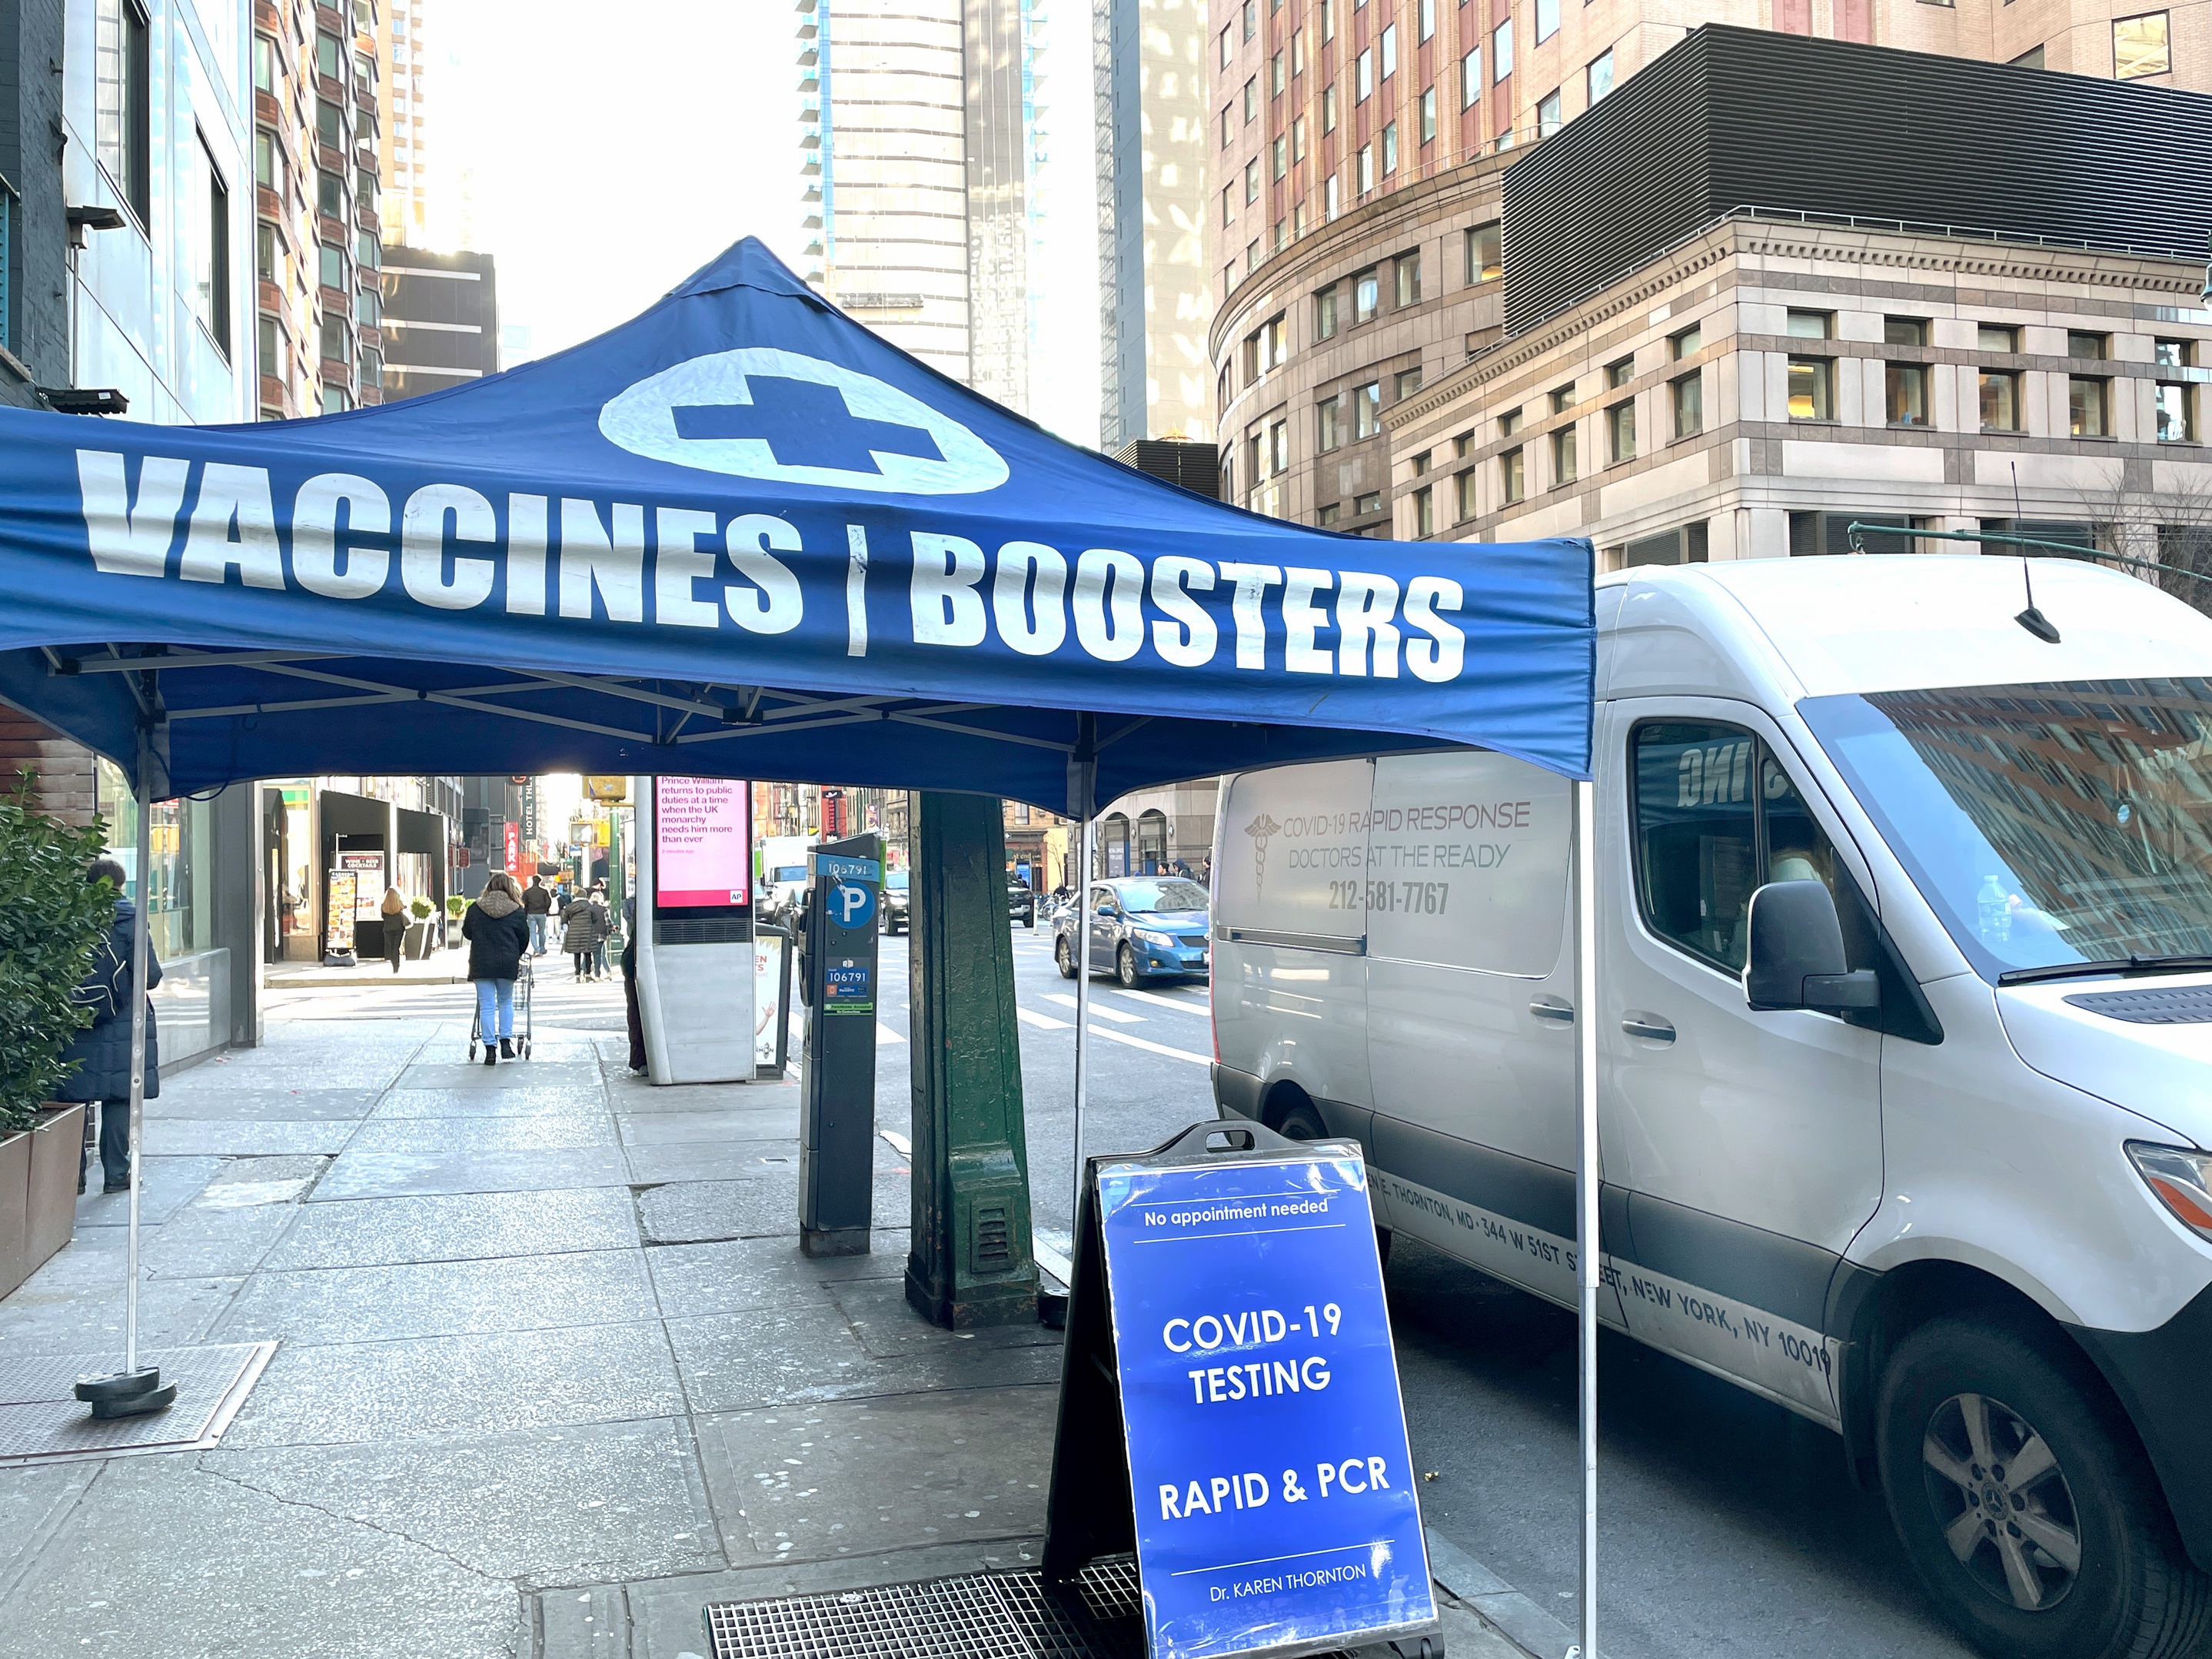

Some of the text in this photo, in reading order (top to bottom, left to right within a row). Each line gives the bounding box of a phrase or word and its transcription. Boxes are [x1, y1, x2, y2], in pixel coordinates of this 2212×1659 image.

[76, 449, 803, 634] VACCINES
[910, 530, 1465, 683] BOOSTERS
[661, 776, 690, 785] Prince
[706, 786, 733, 796] public
[661, 796, 689, 804] duties
[709, 796, 728, 804] time
[662, 806, 719, 814] when the UK
[662, 816, 707, 825] monarchy
[662, 825, 689, 833] needs
[691, 825, 708, 833] him
[1283, 801, 1531, 838] COVID-19 RAPID RESPONSE
[507, 831, 516, 863] PARK
[662, 835, 682, 843] than
[828, 863, 867, 876] 106791
[1289, 844, 1511, 869] DOCTORS AT THE READY
[1329, 880, 1449, 915] 212-581-7767
[830, 972, 866, 982] 106791
[1144, 1198, 1329, 1228] No appointment needed
[1392, 1183, 1454, 1226] THORNTON,
[1457, 1209, 1474, 1230] MD
[1481, 1217, 1507, 1245] 344
[1508, 1228, 1524, 1252] W
[1528, 1235, 1559, 1265] 51ST
[1565, 1251, 1628, 1296] SEET,
[1632, 1275, 1671, 1308] NEW
[1677, 1292, 1738, 1339] YORK,
[1743, 1317, 1769, 1348] NY
[1163, 1302, 1342, 1353] COVID-19
[1189, 1356, 1331, 1405] TESTING
[1159, 1456, 1390, 1521] RAPID & PCR
[1209, 1564, 1367, 1602] Dr. KAREN THORNTON
